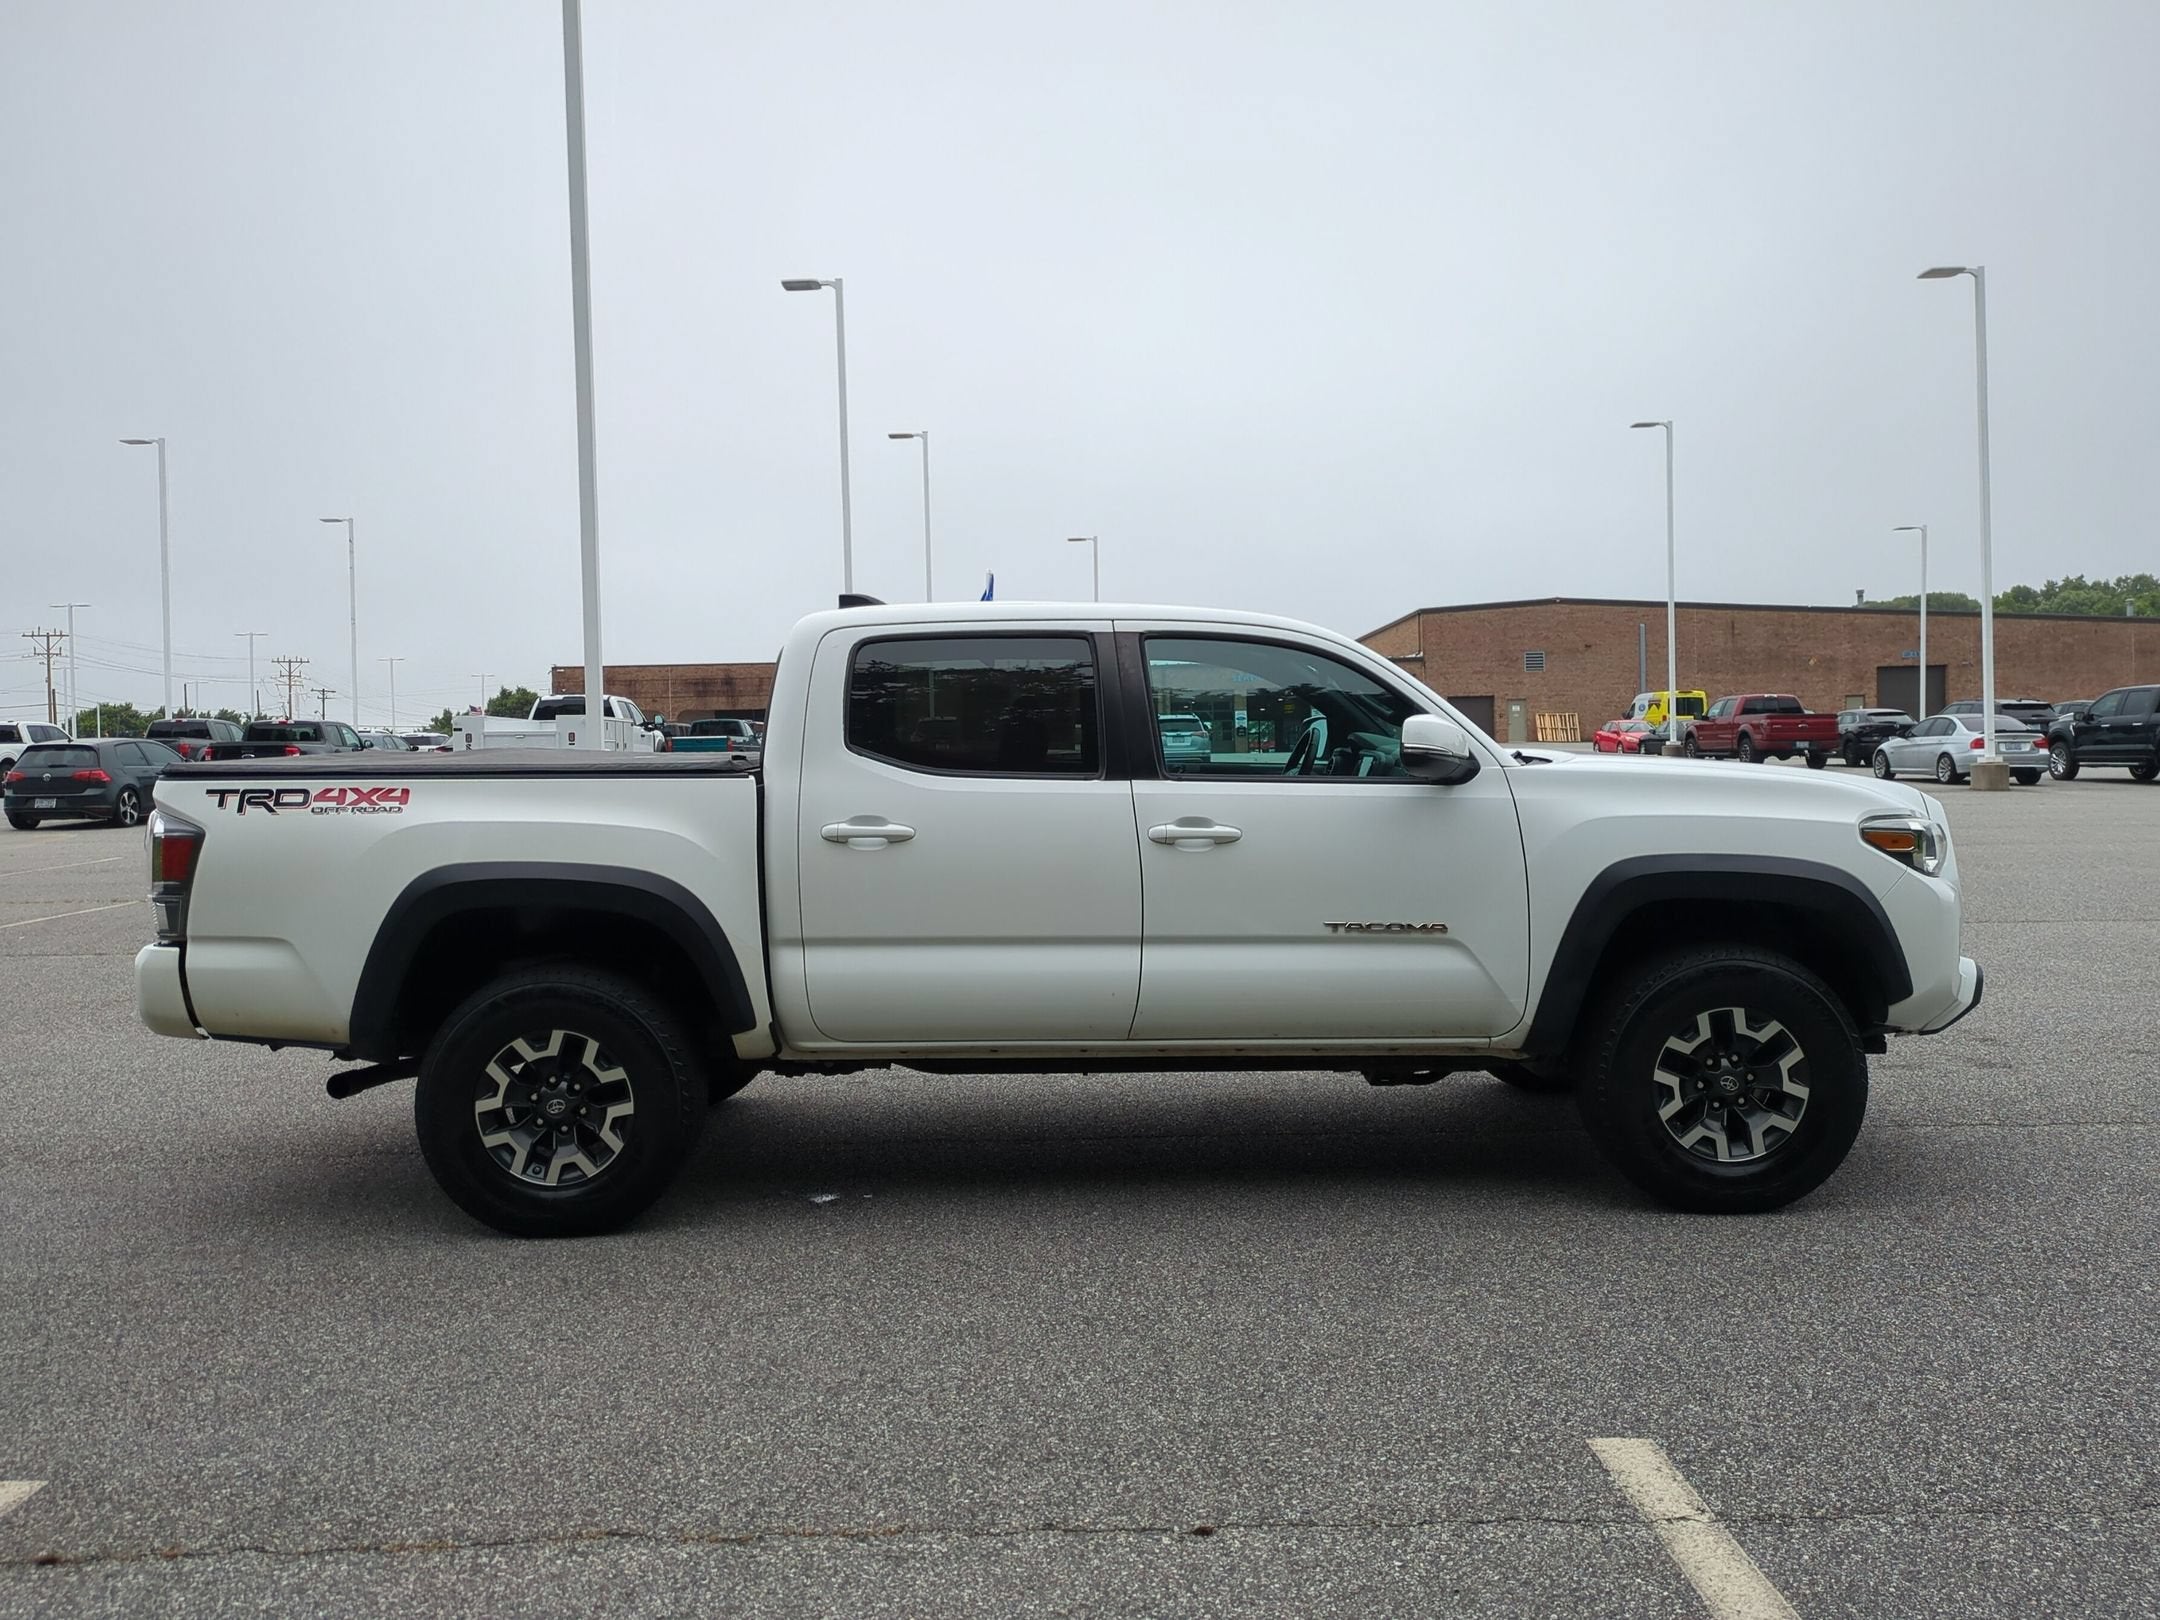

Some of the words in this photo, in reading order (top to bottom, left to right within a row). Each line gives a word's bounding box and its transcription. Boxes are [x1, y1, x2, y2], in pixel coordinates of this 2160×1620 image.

[206, 788, 314, 815] TRD
[312, 787, 411, 807] 4X4
[310, 806, 348, 815] OFF
[350, 806, 403, 815] ROAD
[1323, 921, 1449, 934] TACOMA
